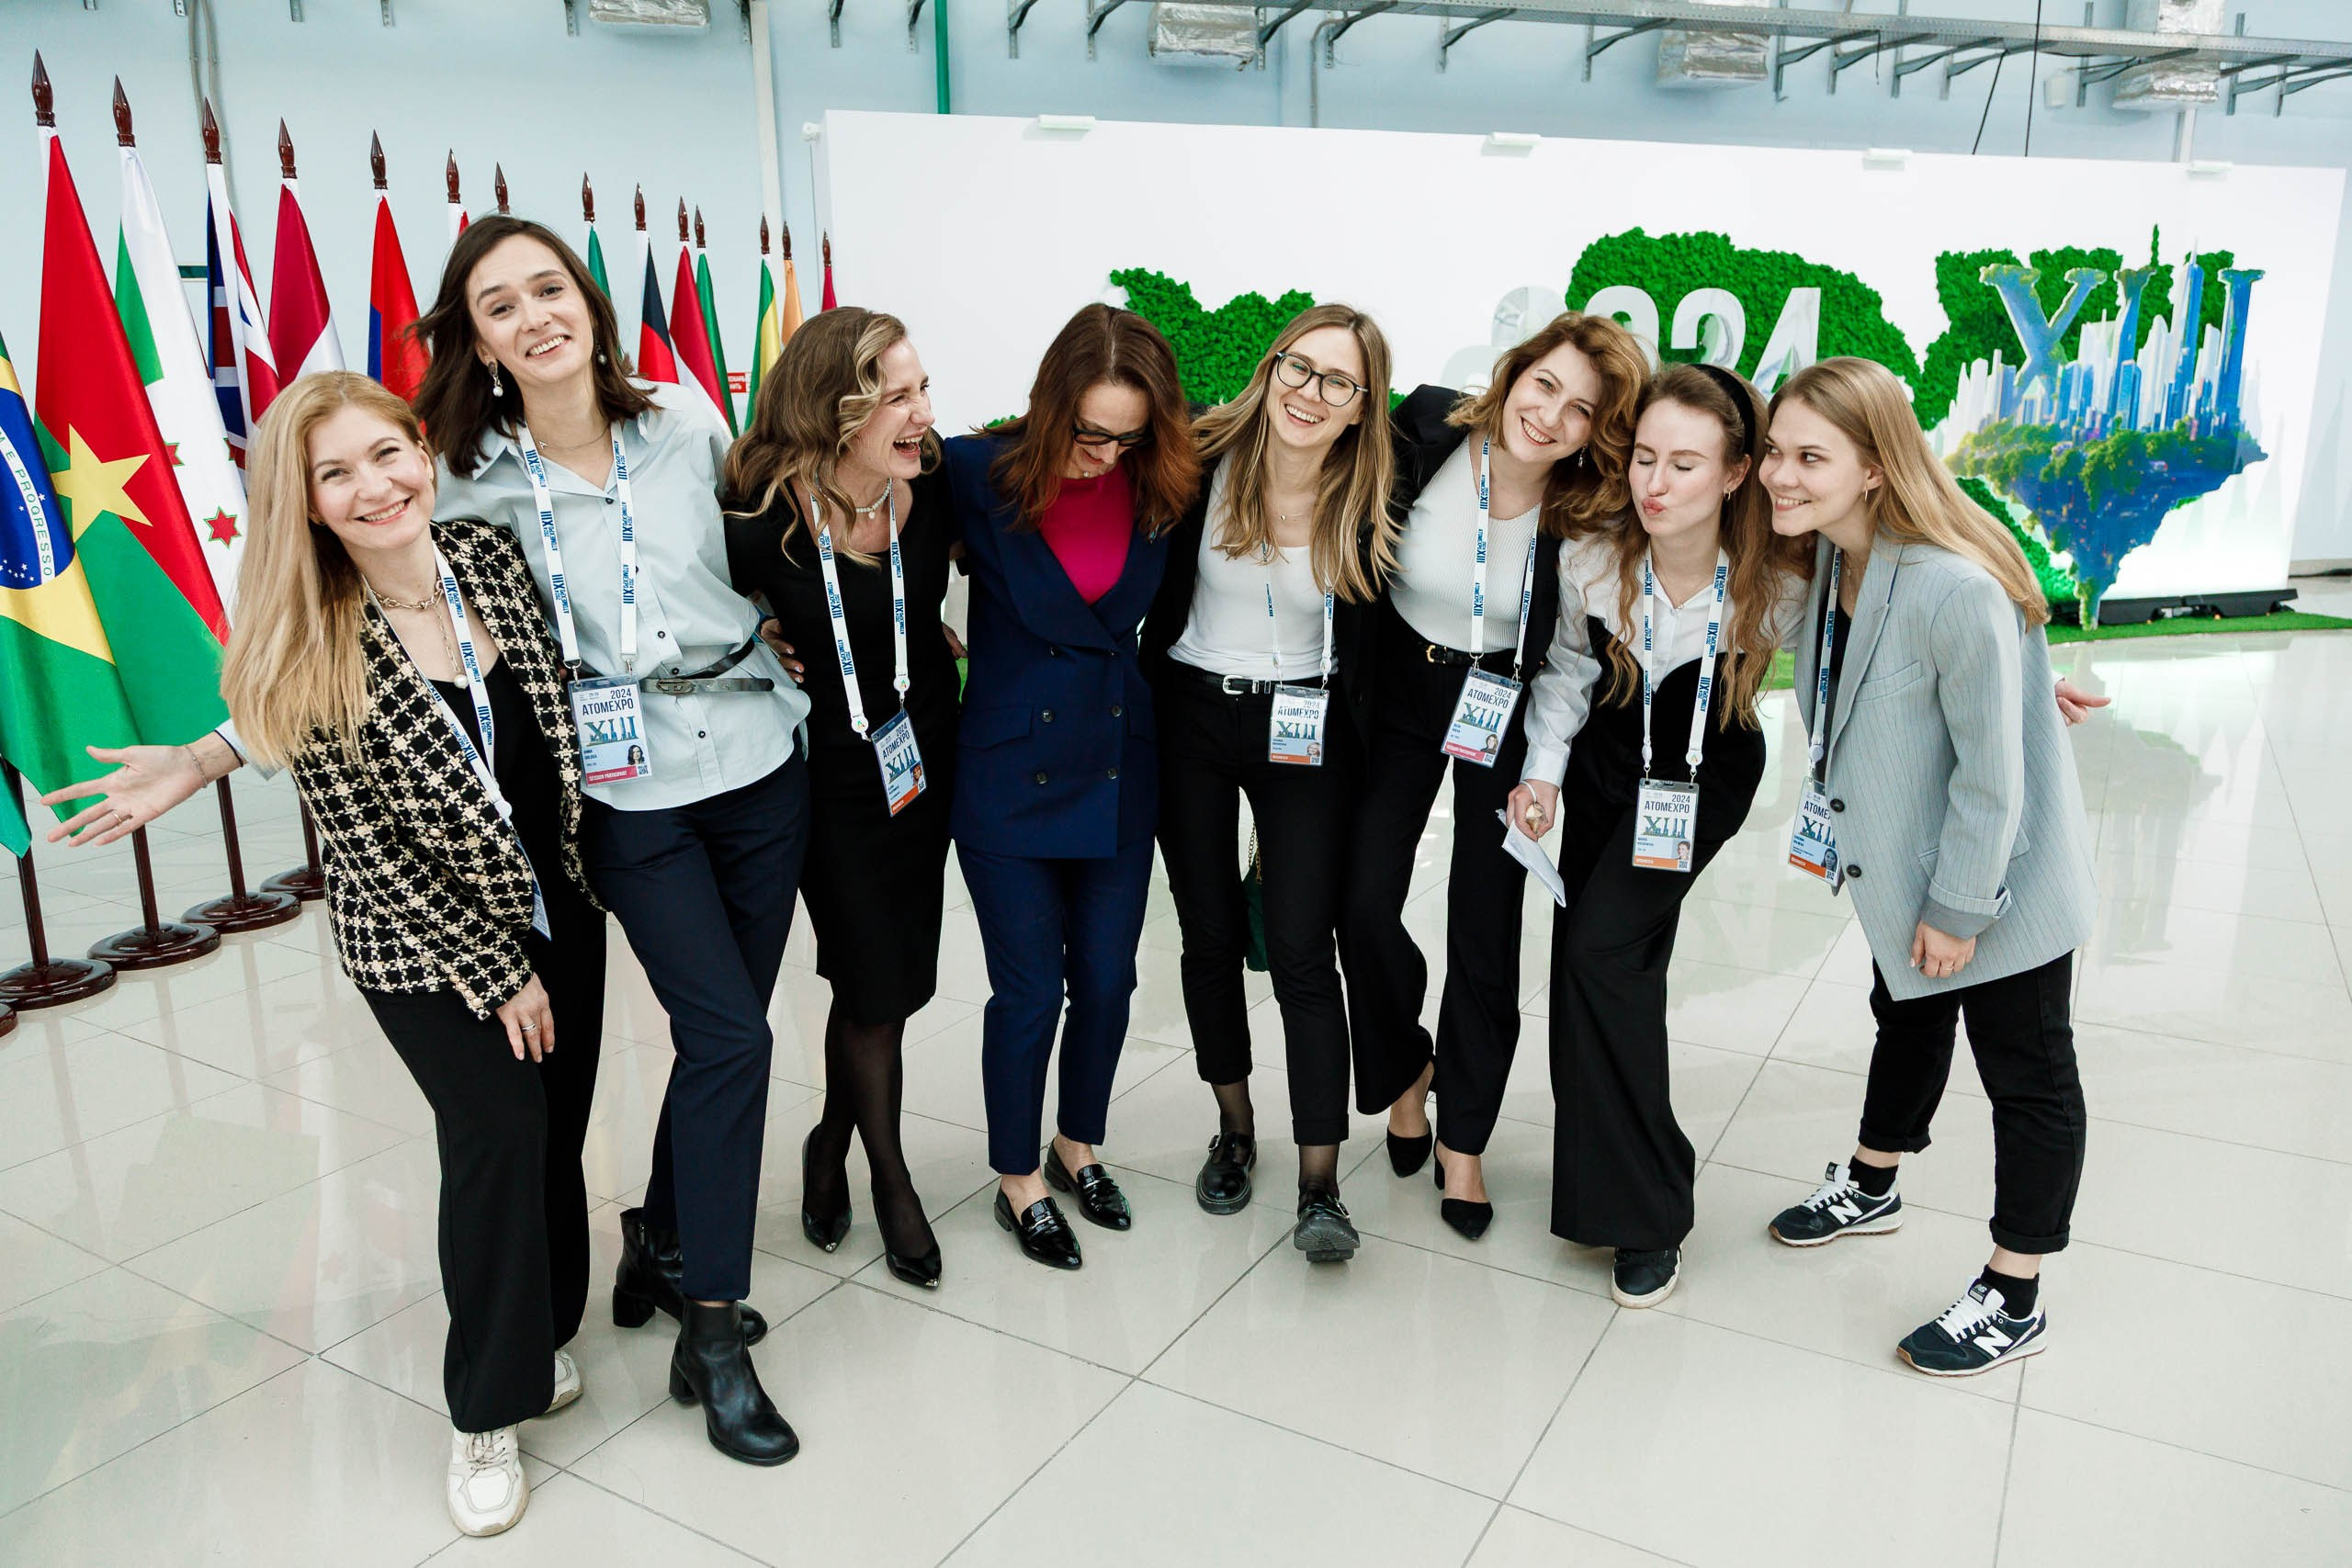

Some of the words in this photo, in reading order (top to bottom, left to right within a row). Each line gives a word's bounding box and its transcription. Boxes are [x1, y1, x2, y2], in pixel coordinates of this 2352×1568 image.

[1492, 286, 1822, 406] 24
[525, 449, 539, 465] XIII
[616, 465, 628, 479] XIII
[1480, 496, 1488, 509] XIII
[15, 468, 52, 576] PROGRESSO
[540, 511, 553, 527] XIII
[622, 527, 633, 541] XIII
[1476, 550, 1486, 563] XIII
[1715, 566, 1727, 580] XIII
[444, 577, 458, 593] XIII
[552, 574, 565, 590] XIII
[623, 589, 634, 604] XIII
[830, 604, 843, 619] XIII
[895, 599, 904, 613] XIII
[1473, 603, 1483, 616] XIII
[1707, 622, 1719, 636] XIII
[460, 642, 474, 658] XIII
[841, 661, 854, 675] XIII
[1699, 677, 1711, 691] XIII
[611, 688, 632, 699] 2024
[1467, 689, 1508, 708] ATOMEXPO
[1494, 688, 1512, 699] 2024
[582, 698, 633, 716] ATOMEXPO
[1278, 706, 1319, 719] ATOMEXPO
[478, 706, 490, 723] XIII
[896, 723, 907, 736] 2024
[882, 731, 910, 759] ATOMEXPO
[463, 745, 478, 761] XIII
[1672, 794, 1690, 803] 2024
[1645, 801, 1690, 813] ATOMEXPO
[1828, 1198, 1863, 1225] N
[1973, 1325, 2014, 1358] N
